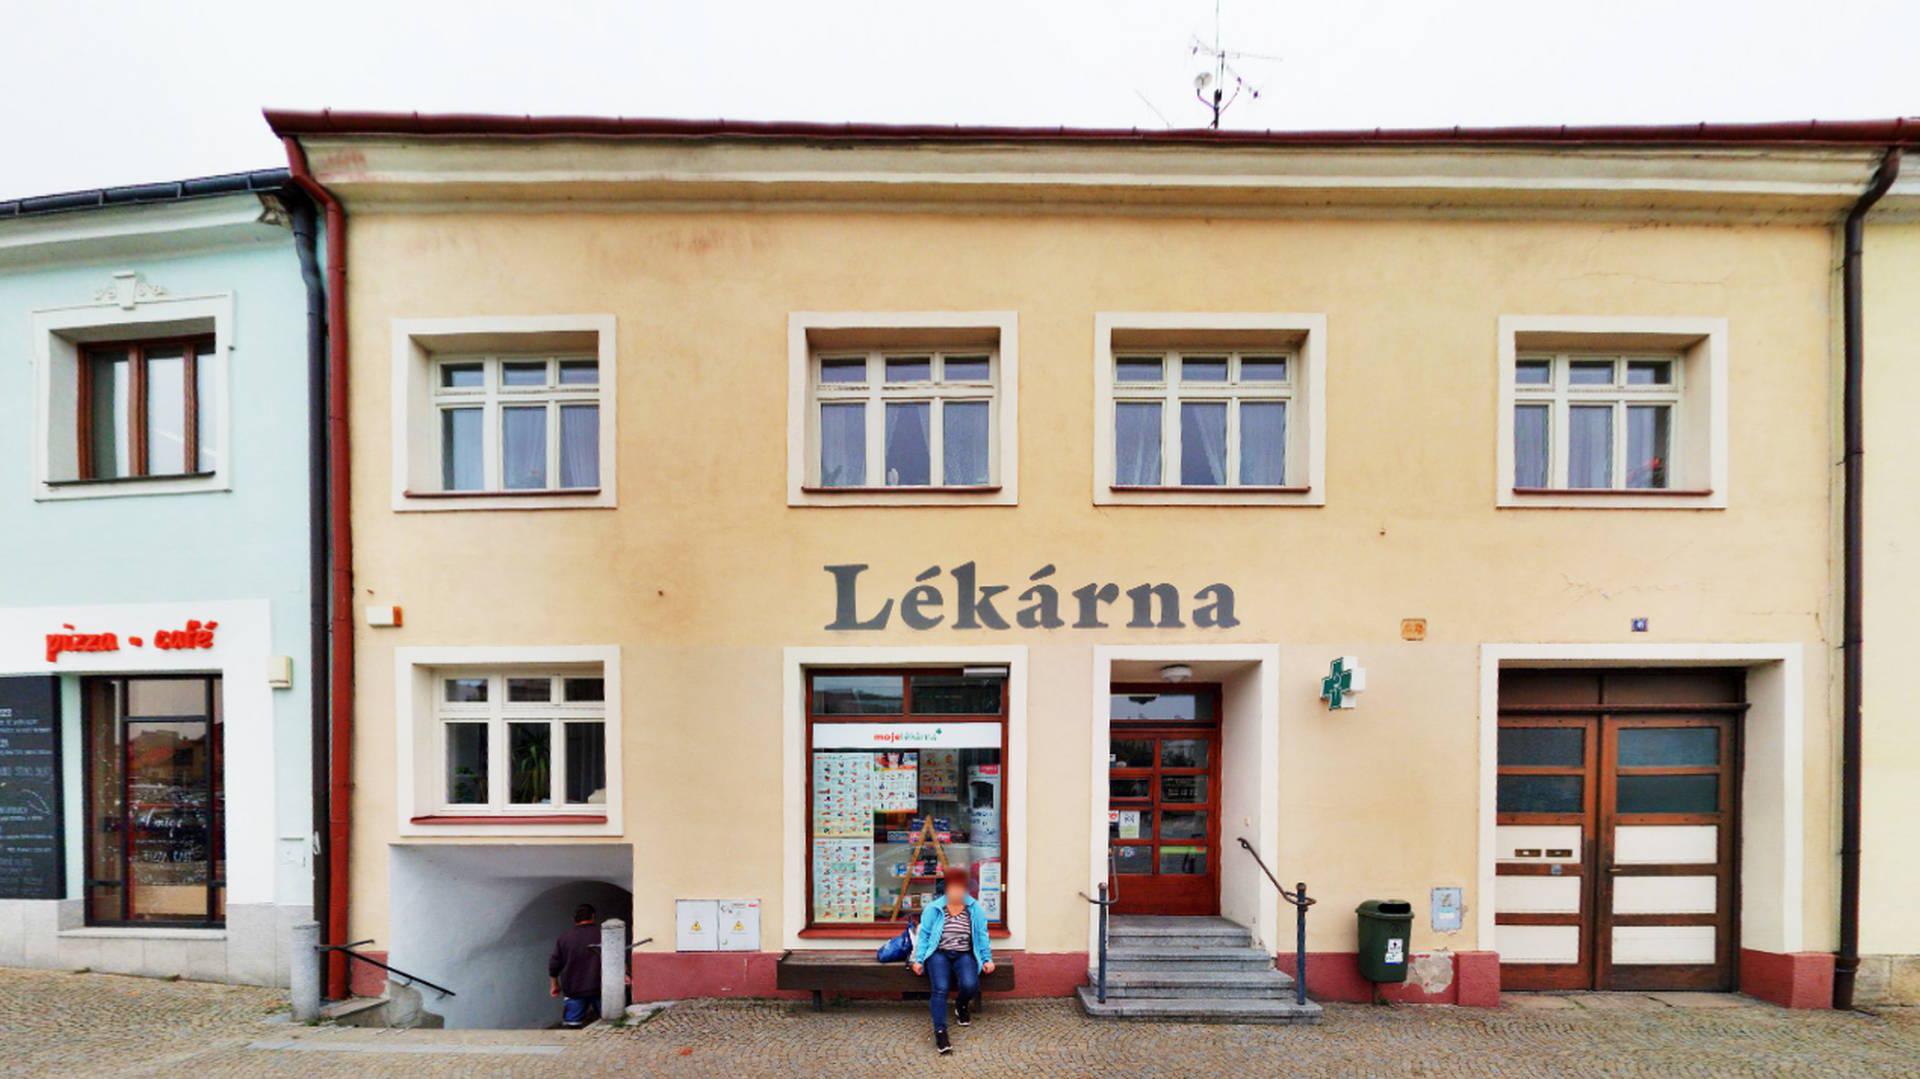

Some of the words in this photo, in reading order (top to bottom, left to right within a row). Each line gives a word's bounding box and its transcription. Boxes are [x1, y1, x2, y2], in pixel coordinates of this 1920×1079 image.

[823, 560, 1241, 631] Lékárna
[45, 623, 119, 663] pizza
[154, 619, 218, 650] café
